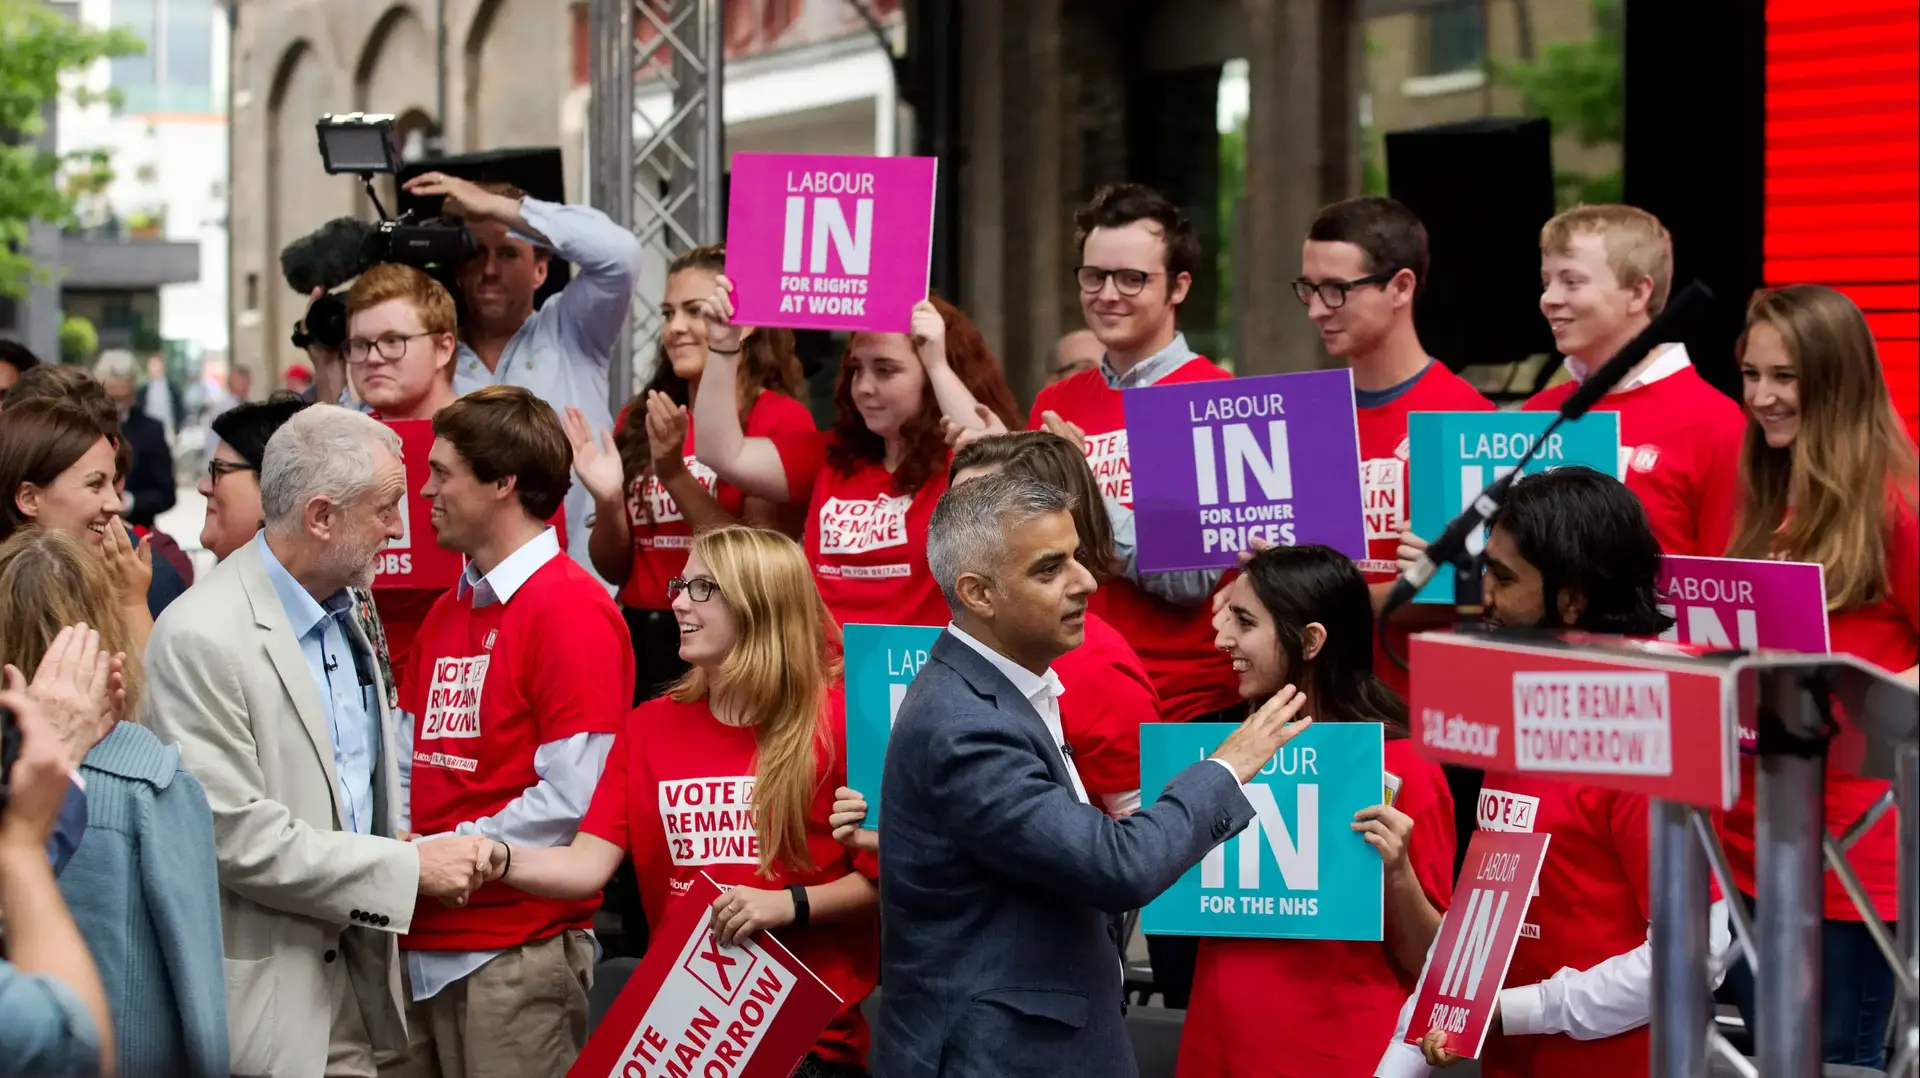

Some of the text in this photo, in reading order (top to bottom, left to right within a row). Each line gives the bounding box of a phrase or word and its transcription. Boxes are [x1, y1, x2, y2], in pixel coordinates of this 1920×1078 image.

[787, 171, 875, 194] LABOUR
[782, 196, 874, 276] IN
[781, 276, 868, 295] FOR RIGHTS
[780, 295, 866, 316] AT WORK
[1189, 394, 1285, 422] LABOUR
[1084, 436, 1117, 458] OTE
[1460, 433, 1564, 460] LABOUR
[1192, 420, 1293, 506] IN
[1105, 479, 1131, 499] NE
[835, 497, 889, 517] VOTE
[1200, 504, 1295, 525] FOR LOWER
[823, 523, 899, 549] 23 JUNE
[824, 512, 898, 534] REMAIN
[1364, 513, 1396, 534] NE
[376, 553, 413, 575] OBS
[871, 566, 908, 576] BRITAIN
[1668, 577, 1754, 604] ABOUR
[438, 662, 472, 684] VOTE
[887, 649, 930, 677] LAB
[1519, 684, 1663, 720] VOTE REMAIN
[1522, 727, 1645, 765] TOMORROW
[447, 757, 476, 769] BRITAIN
[665, 781, 736, 807] VOTE
[1480, 793, 1513, 824] VOTE
[666, 810, 759, 834] REMAIN
[672, 836, 759, 860] 23 JUNE
[1476, 852, 1520, 882] LABOUR
[1201, 896, 1319, 916] FOR THE NHS
[1438, 888, 1509, 1001] IN
[703, 964, 784, 1078] ORROW
[1427, 1002, 1471, 1035] FOR JOBS
[622, 1024, 669, 1078] OTE
[658, 1004, 721, 1078] MAIN
